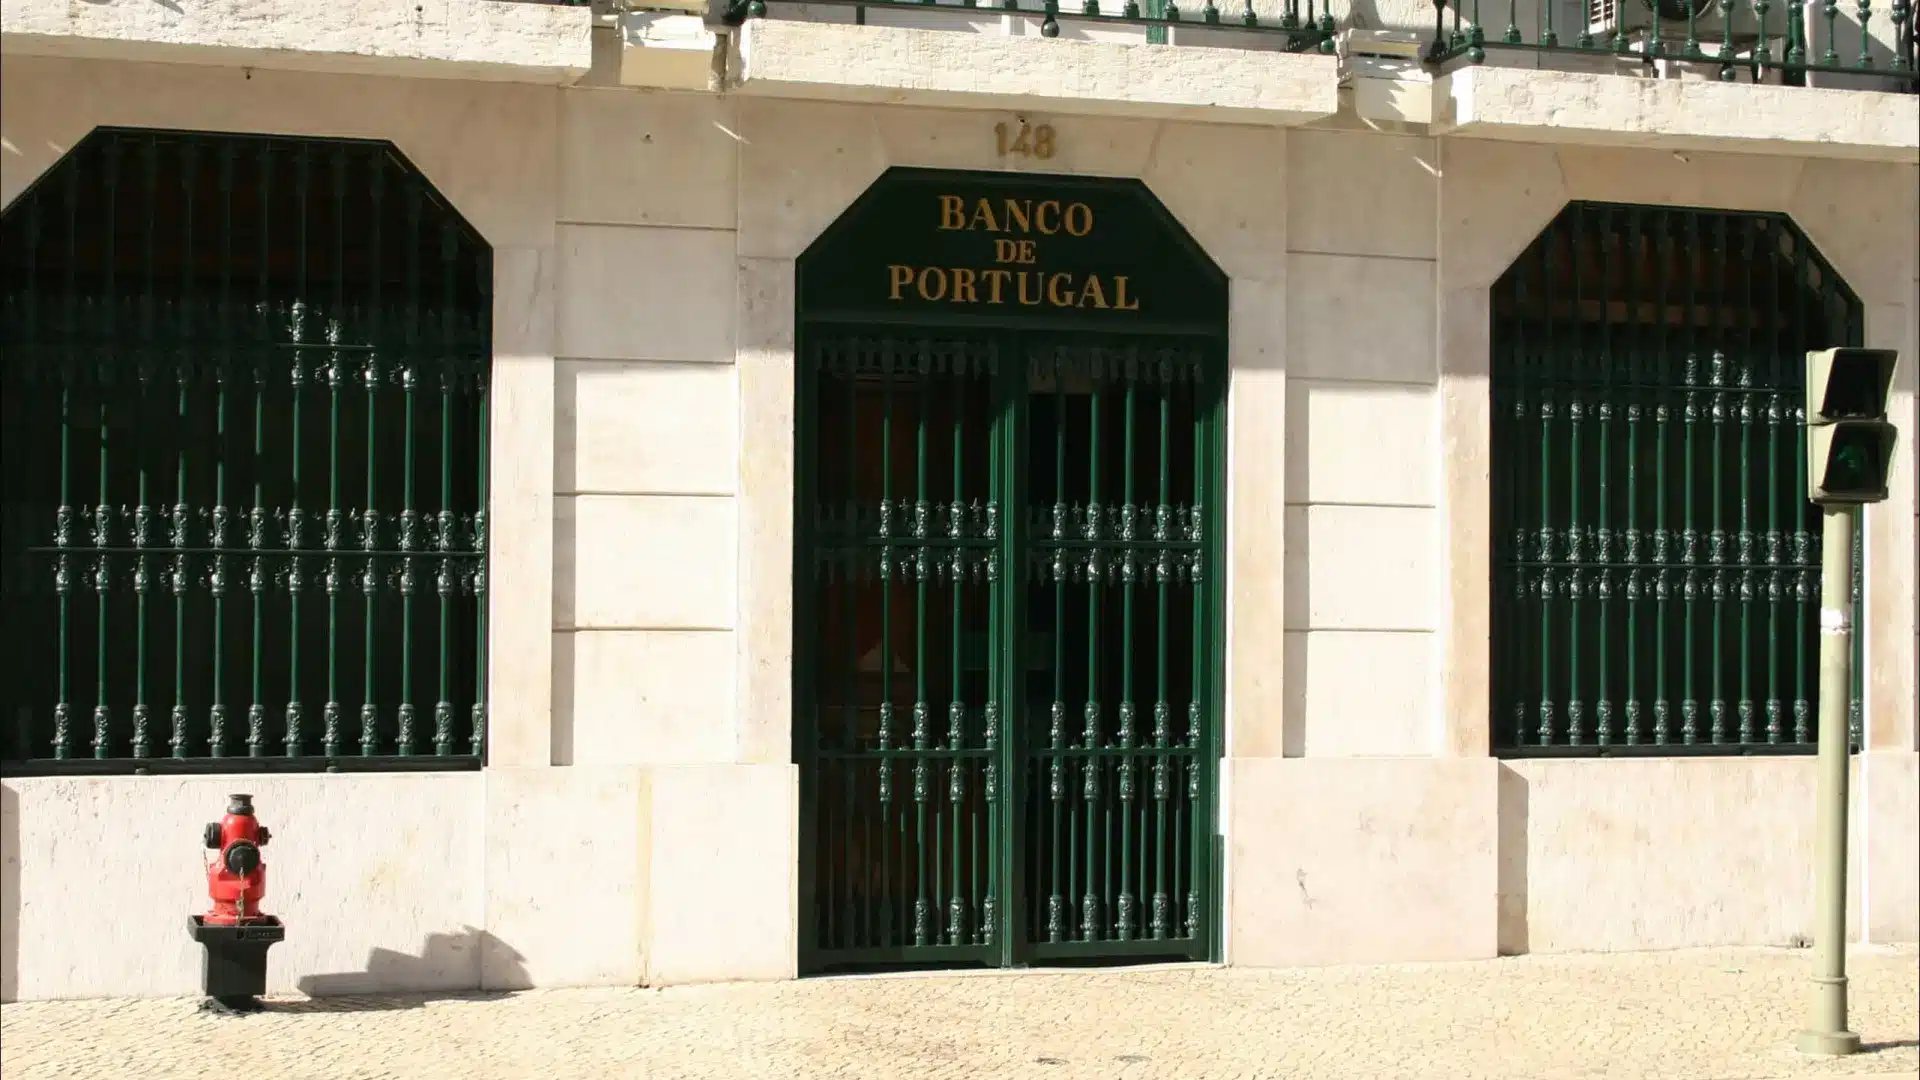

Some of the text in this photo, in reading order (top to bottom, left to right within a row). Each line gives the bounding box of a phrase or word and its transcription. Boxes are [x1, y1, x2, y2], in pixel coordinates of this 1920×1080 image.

[994, 122, 1057, 159] 148
[937, 195, 1093, 236] BANCO
[994, 239, 1037, 264] DE
[888, 265, 1139, 310] PORTUGAL
